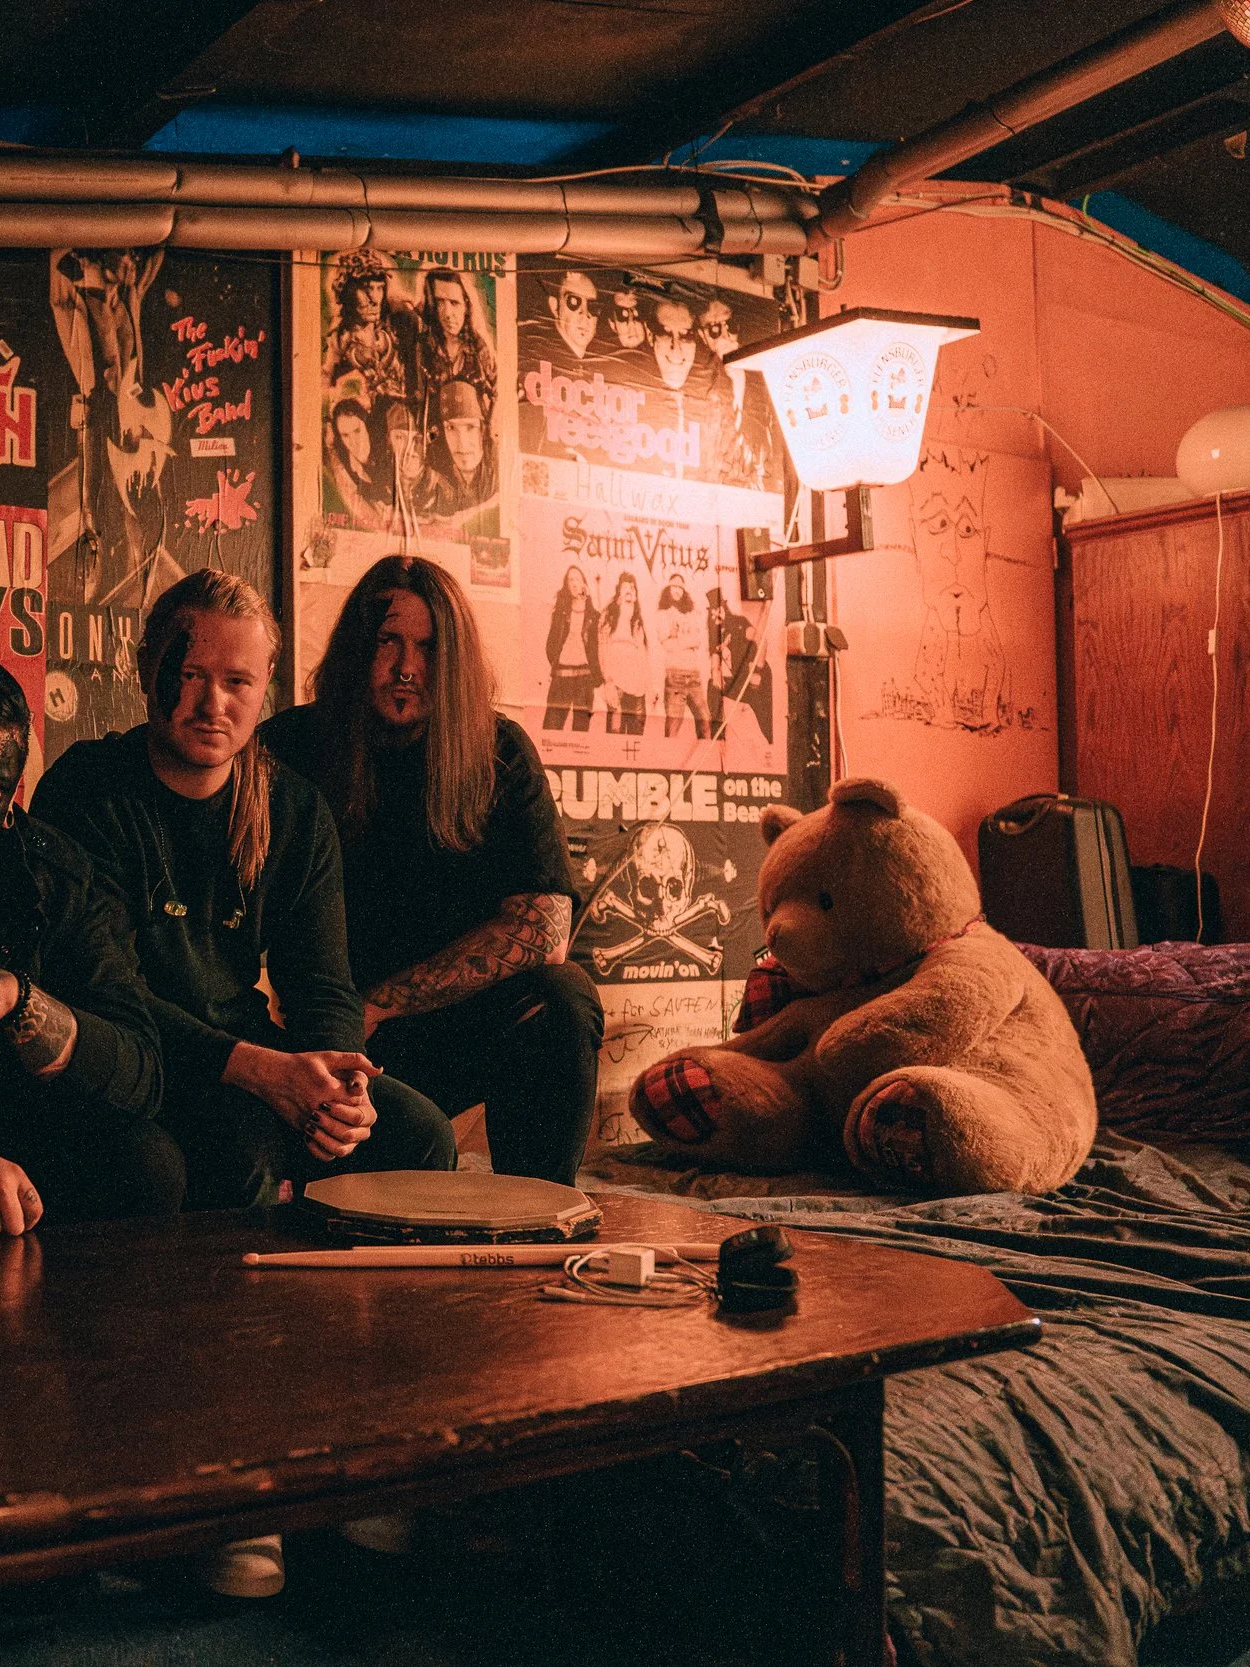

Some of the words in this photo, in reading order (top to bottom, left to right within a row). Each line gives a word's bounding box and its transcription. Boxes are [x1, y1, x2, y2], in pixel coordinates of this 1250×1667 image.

[170, 316, 207, 342] The
[524, 361, 646, 424] doctor
[187, 389, 252, 434] Band
[562, 515, 635, 564] Saint
[625, 524, 710, 578] Vitus
[723, 778, 748, 797] on
[751, 776, 782, 798] the
[723, 802, 759, 822] Bea
